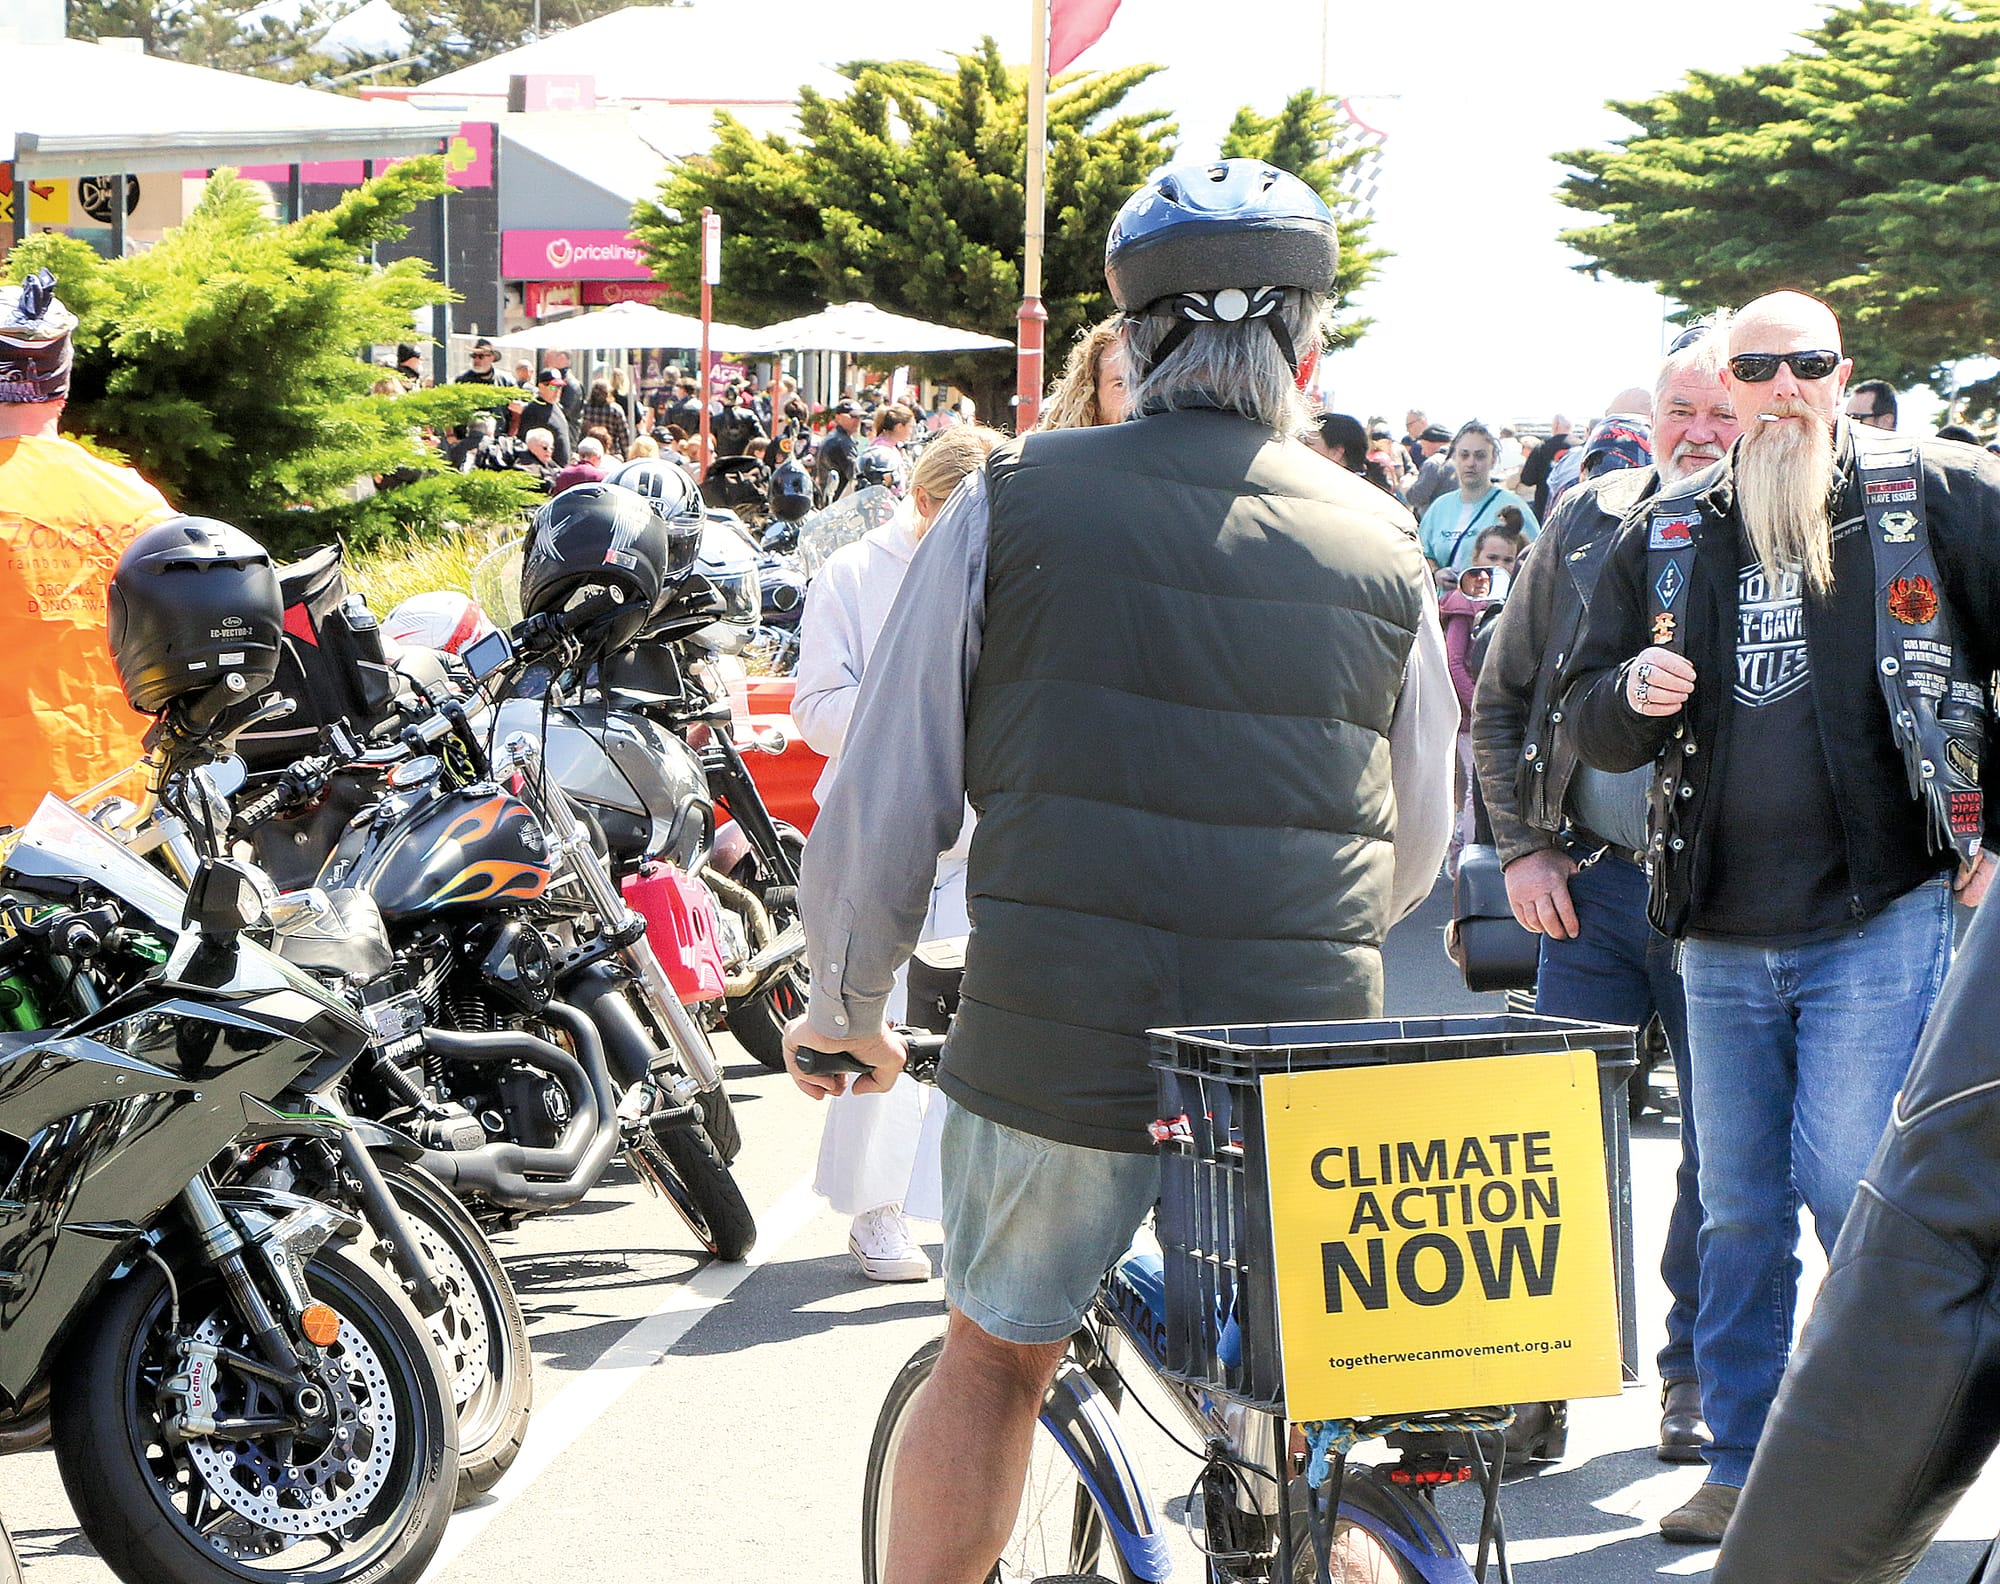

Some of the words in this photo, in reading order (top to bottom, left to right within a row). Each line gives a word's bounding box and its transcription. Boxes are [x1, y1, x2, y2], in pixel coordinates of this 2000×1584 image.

[573, 244, 637, 264] priceline
[1871, 493, 1891, 503] HAVE
[1892, 491, 1918, 502] ISSUES
[1951, 792, 1981, 803] LOUD
[1951, 803, 1980, 813] PIPES
[1951, 813, 1978, 824] SAVE
[1952, 823, 1979, 833] LIVES
[1310, 1131, 1554, 1190] CLIMATE
[1348, 1177, 1561, 1235] ACTION
[1320, 1223, 1562, 1314] NOW
[1329, 1338, 1572, 1369] togetherwecanmovement.org.au
[192, 1361, 203, 1407] brembo
